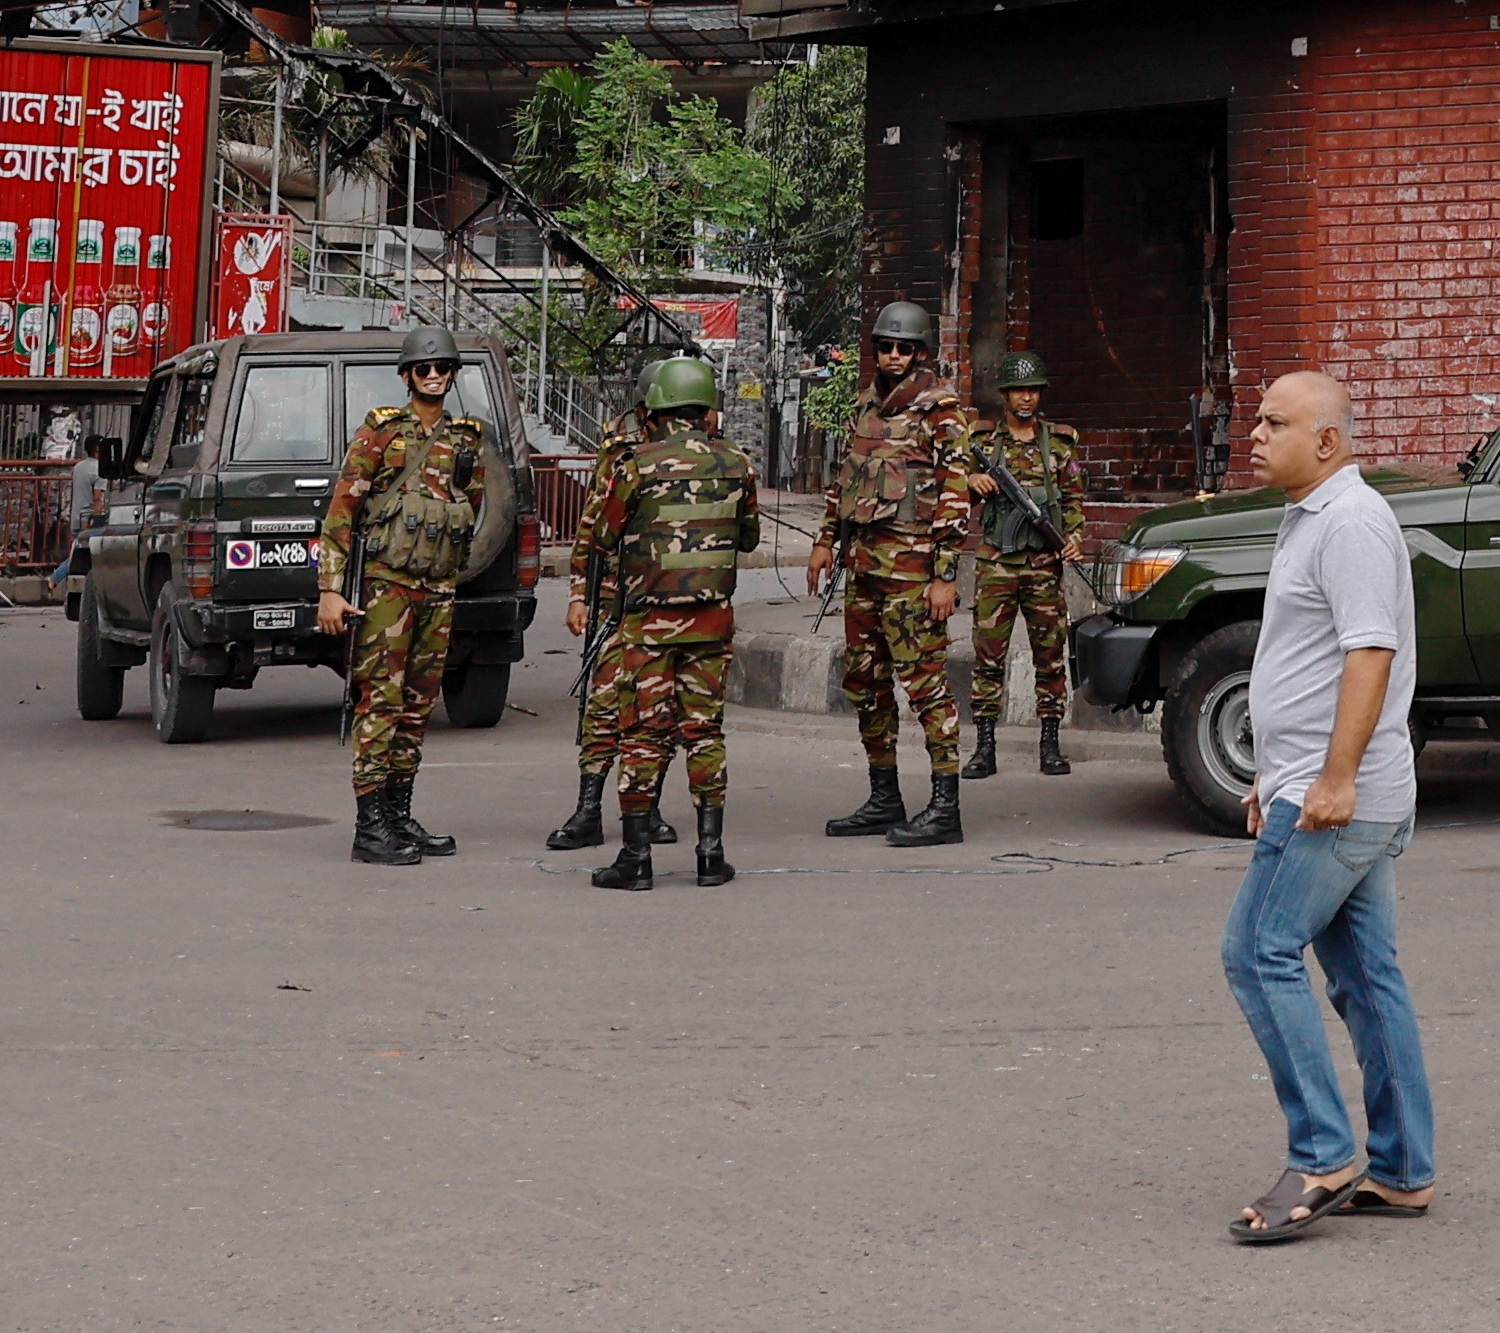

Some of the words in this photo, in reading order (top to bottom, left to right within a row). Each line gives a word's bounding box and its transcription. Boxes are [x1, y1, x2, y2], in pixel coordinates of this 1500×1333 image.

[130, 92, 184, 135] খাই
[118, 140, 181, 191] চাই
[254, 523, 290, 532] TOYOTA
[291, 523, 315, 532] 4WD
